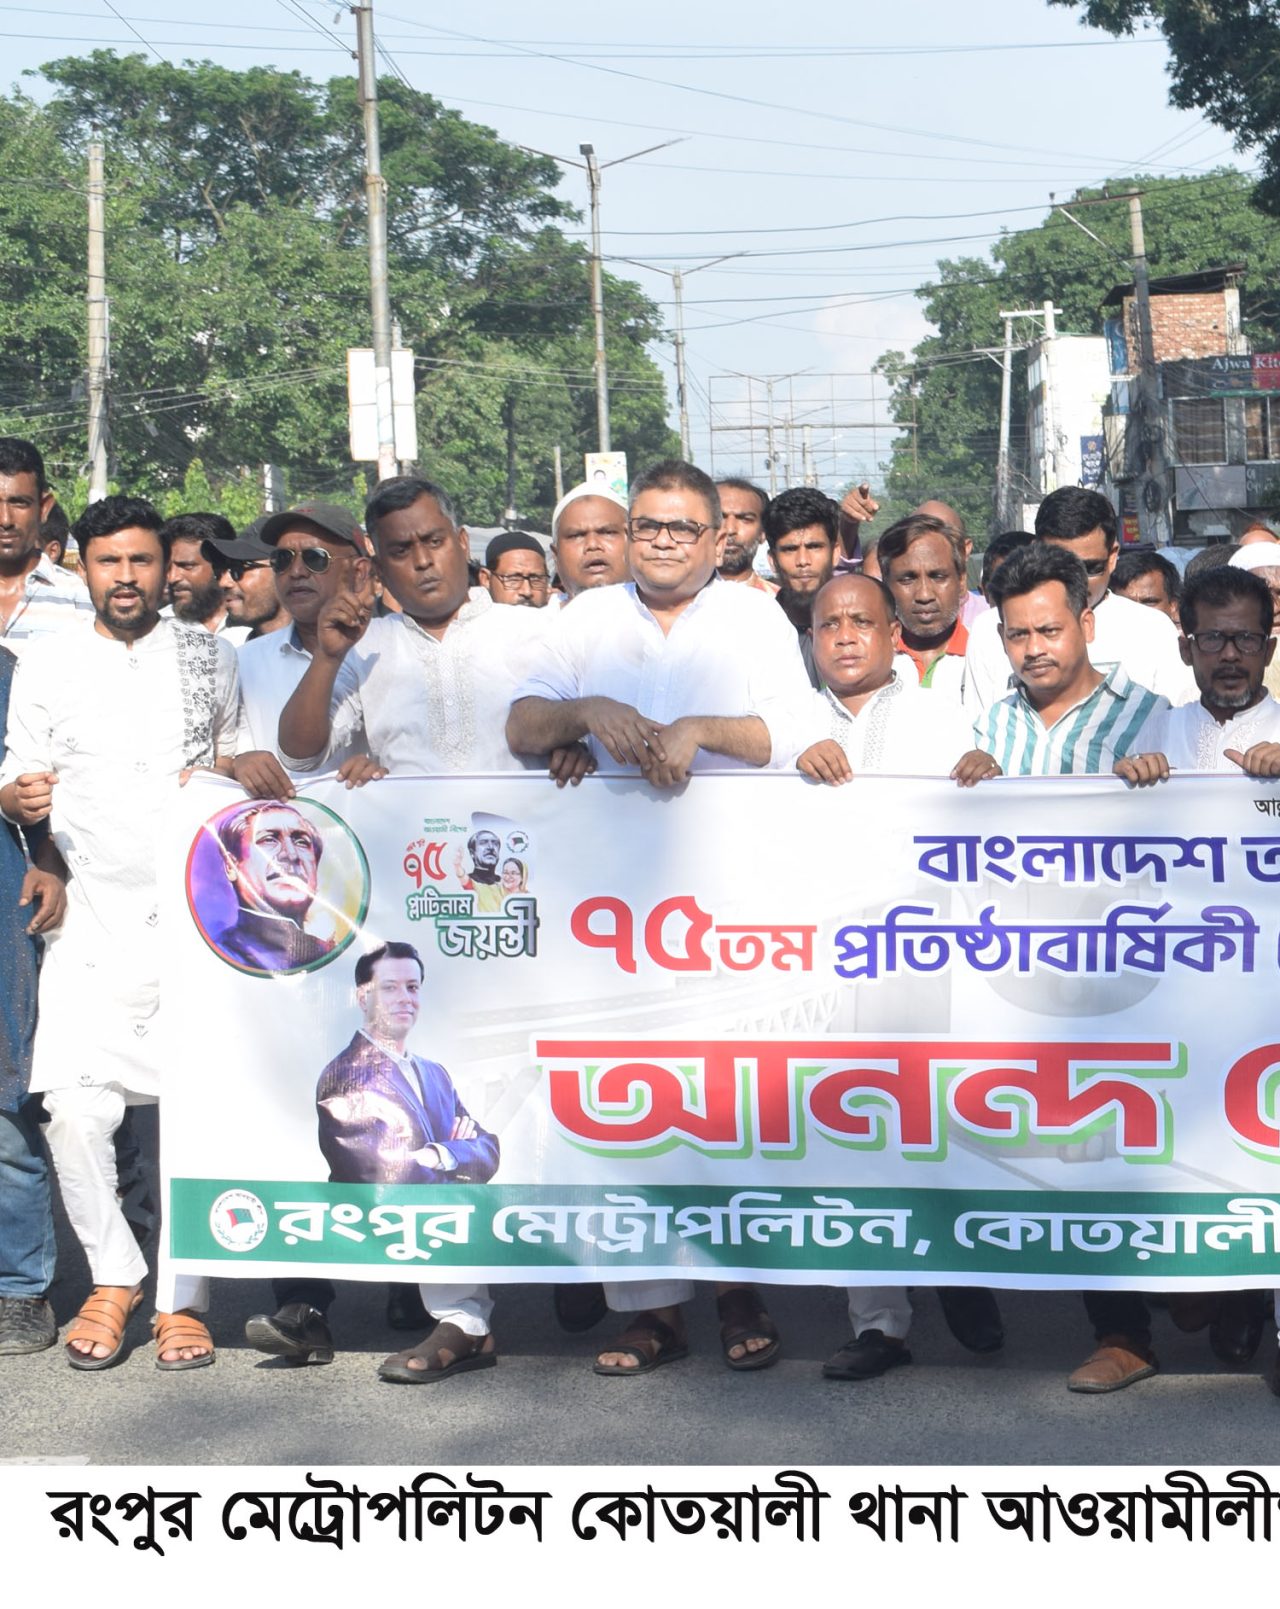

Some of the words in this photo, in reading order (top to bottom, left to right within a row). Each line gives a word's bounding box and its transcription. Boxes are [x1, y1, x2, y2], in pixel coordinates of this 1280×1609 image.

[1212, 358, 1250, 373] Ajwa
[914, 835, 1227, 884] বাংলাদেশ
[407, 885, 475, 920] প্লাটিনাম
[436, 897, 540, 959] জয়ন্তী
[570, 895, 816, 974] ৭৫তম
[834, 902, 1258, 980] প্রতিষ্ঠাবার্ষিকী
[537, 1041, 1187, 1162] আনন্দ
[275, 1200, 475, 1260] রংপুর
[492, 1192, 932, 1255] মেট্রোপলিটন,
